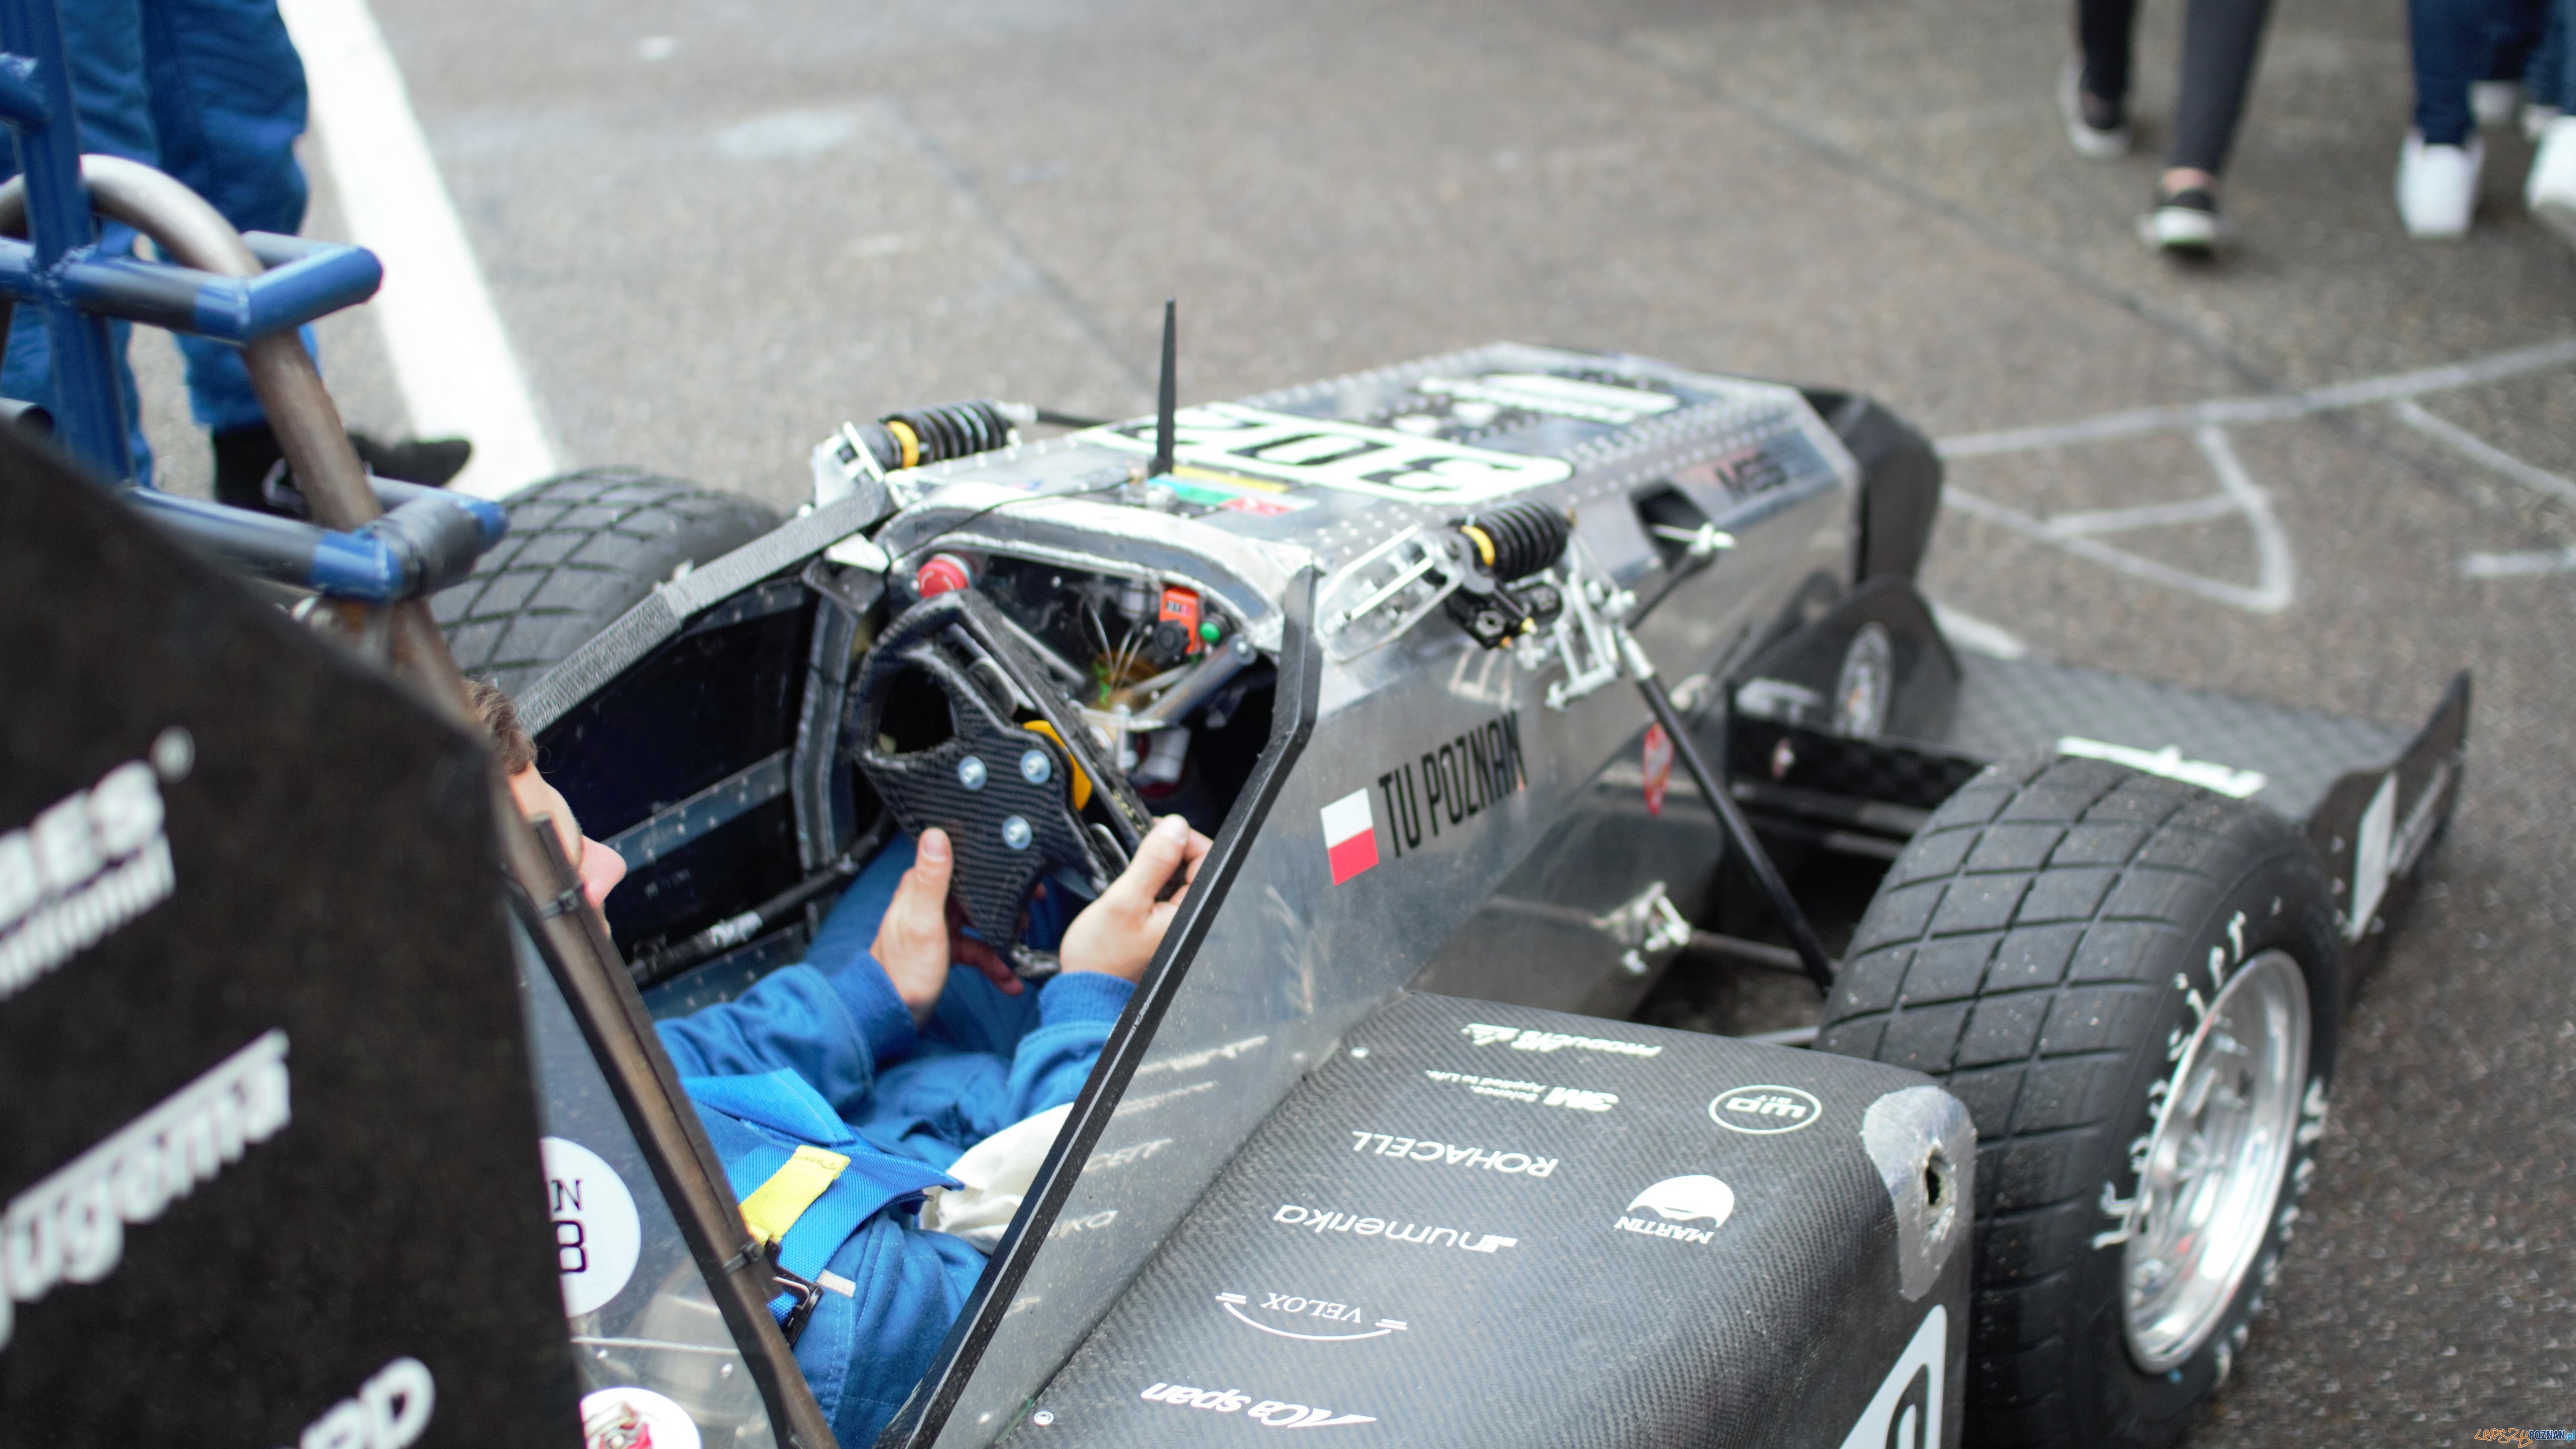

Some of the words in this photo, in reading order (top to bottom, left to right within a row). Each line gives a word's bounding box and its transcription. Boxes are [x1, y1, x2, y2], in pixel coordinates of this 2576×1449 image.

[1378, 763, 1422, 858] TU
[1543, 1086, 1620, 1112] 3M
[1352, 1131, 1560, 1178] ROHACELL
[1273, 1204, 1490, 1252] numerika
[1613, 1216, 1715, 1245] MARTIN
[1260, 1292, 1363, 1323] VELOX
